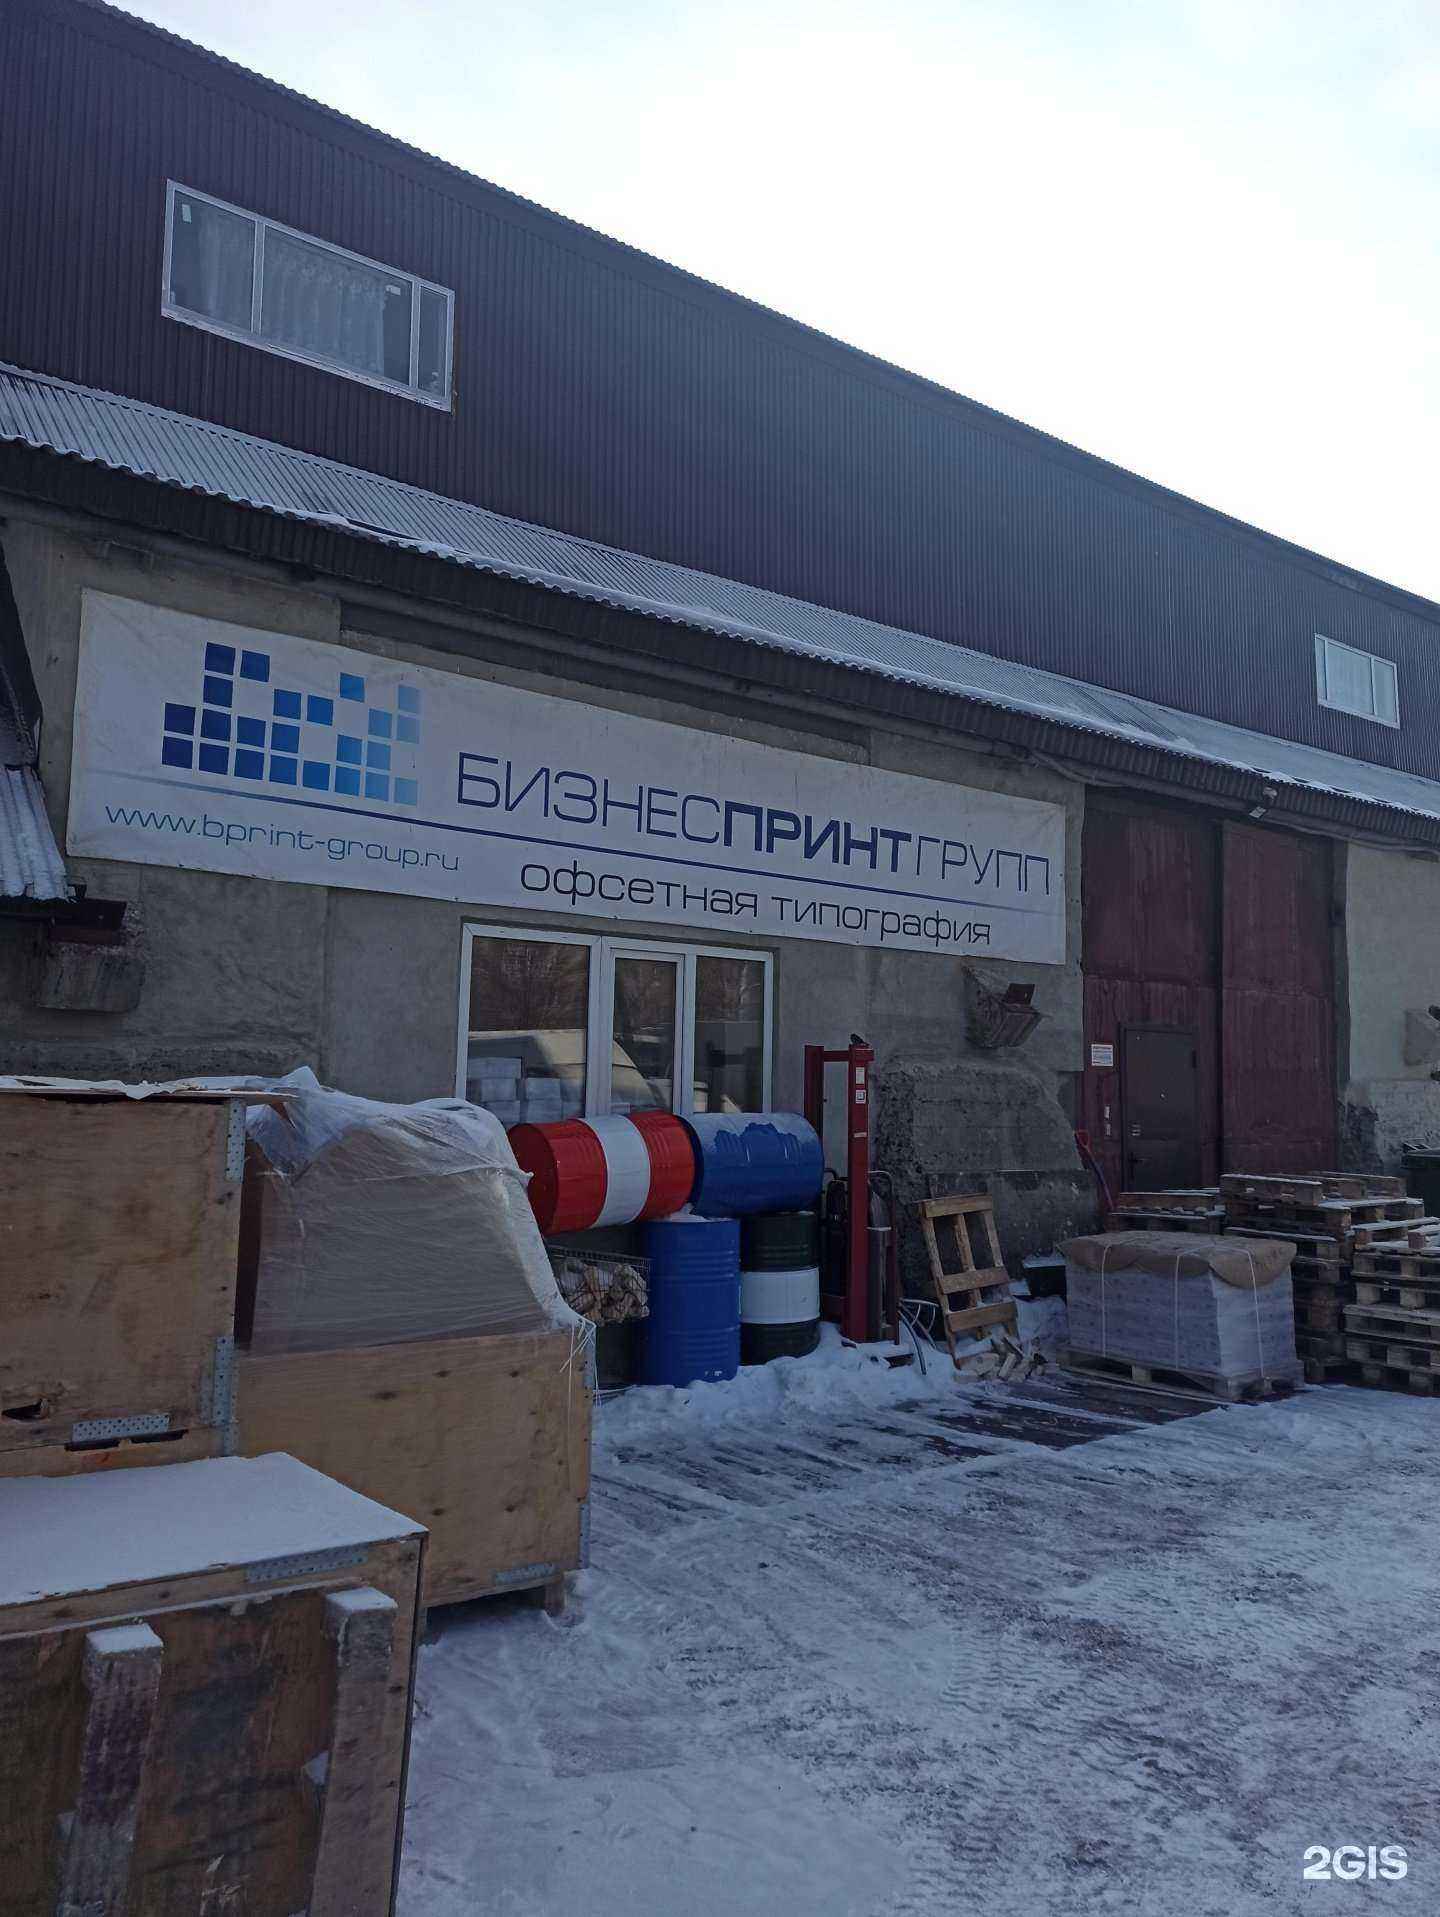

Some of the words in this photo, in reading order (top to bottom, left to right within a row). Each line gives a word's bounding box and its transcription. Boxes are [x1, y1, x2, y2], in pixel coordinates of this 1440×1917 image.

[104, 805, 460, 872] www.bprint-group.ru
[520, 859, 759, 918] офсетная
[771, 895, 992, 947] типография
